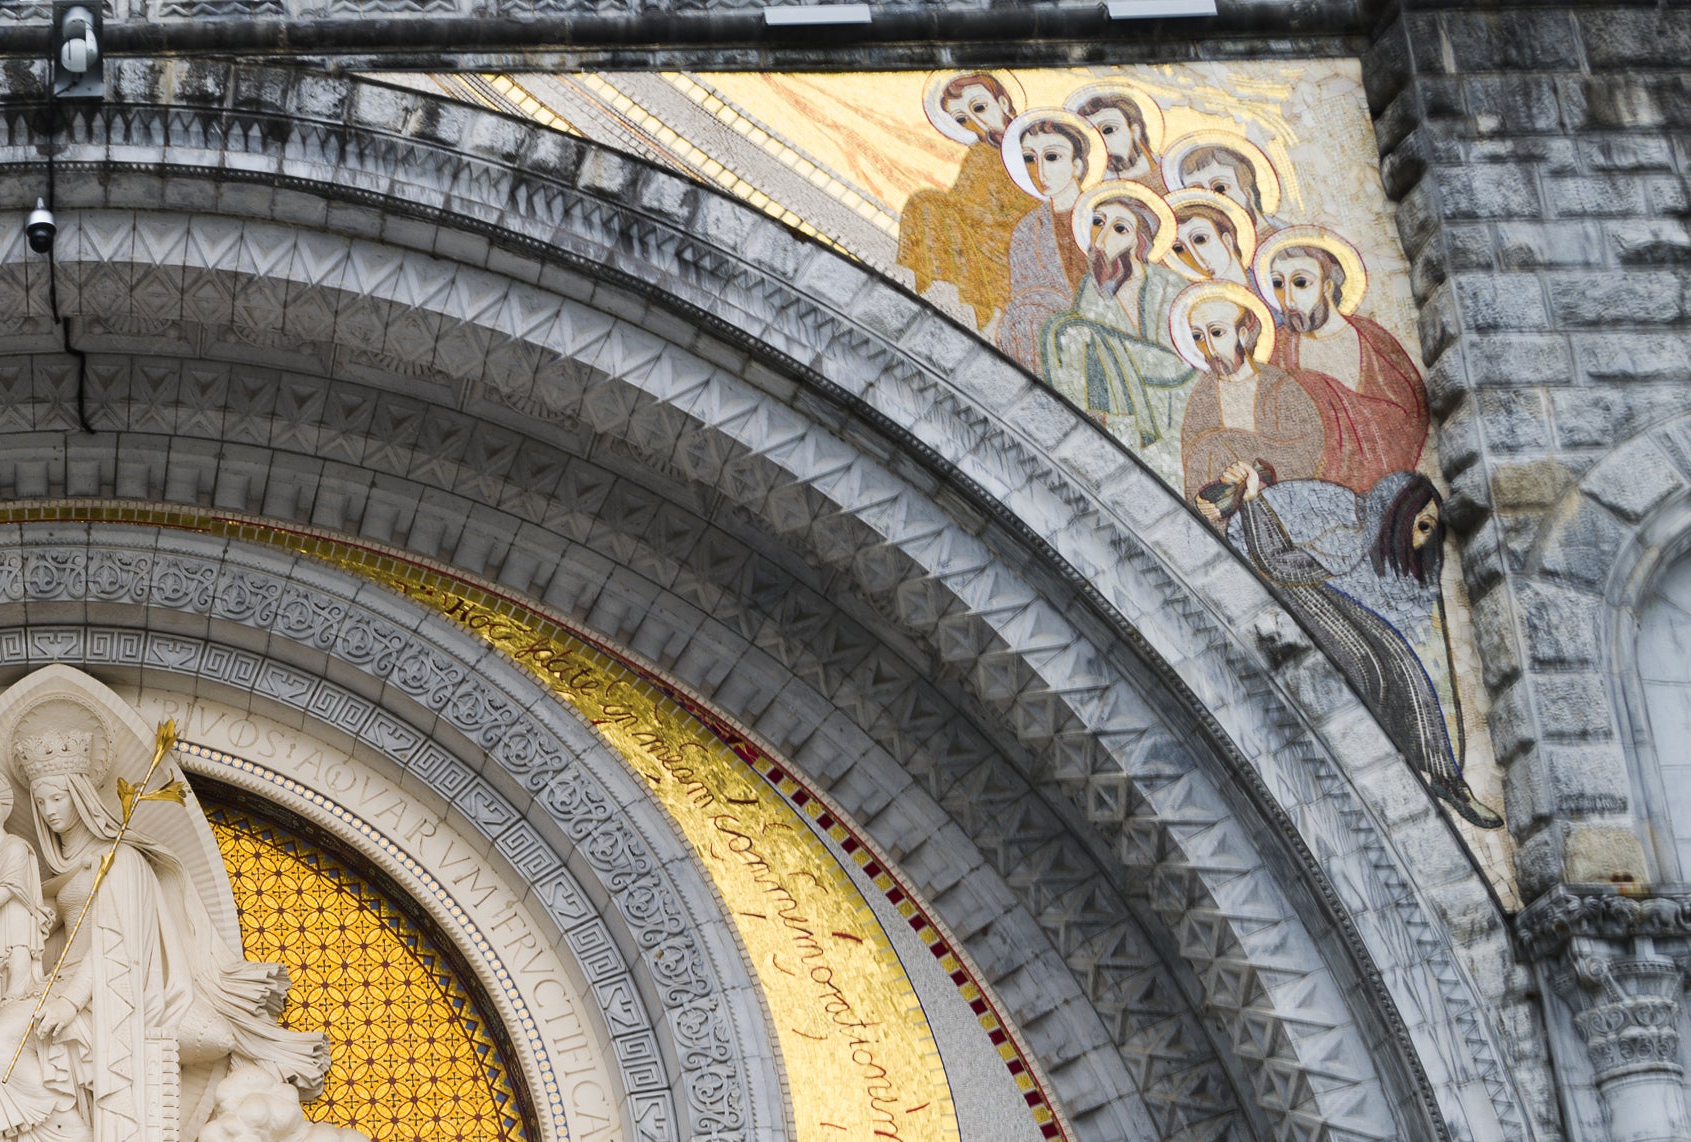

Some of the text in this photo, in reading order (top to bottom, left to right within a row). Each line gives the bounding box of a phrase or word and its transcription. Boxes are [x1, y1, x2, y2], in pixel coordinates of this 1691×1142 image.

[162, 700, 286, 758] RIVOS
[294, 750, 498, 909] AQVARVM
[515, 638, 600, 695] facite
[632, 732, 714, 808] meam
